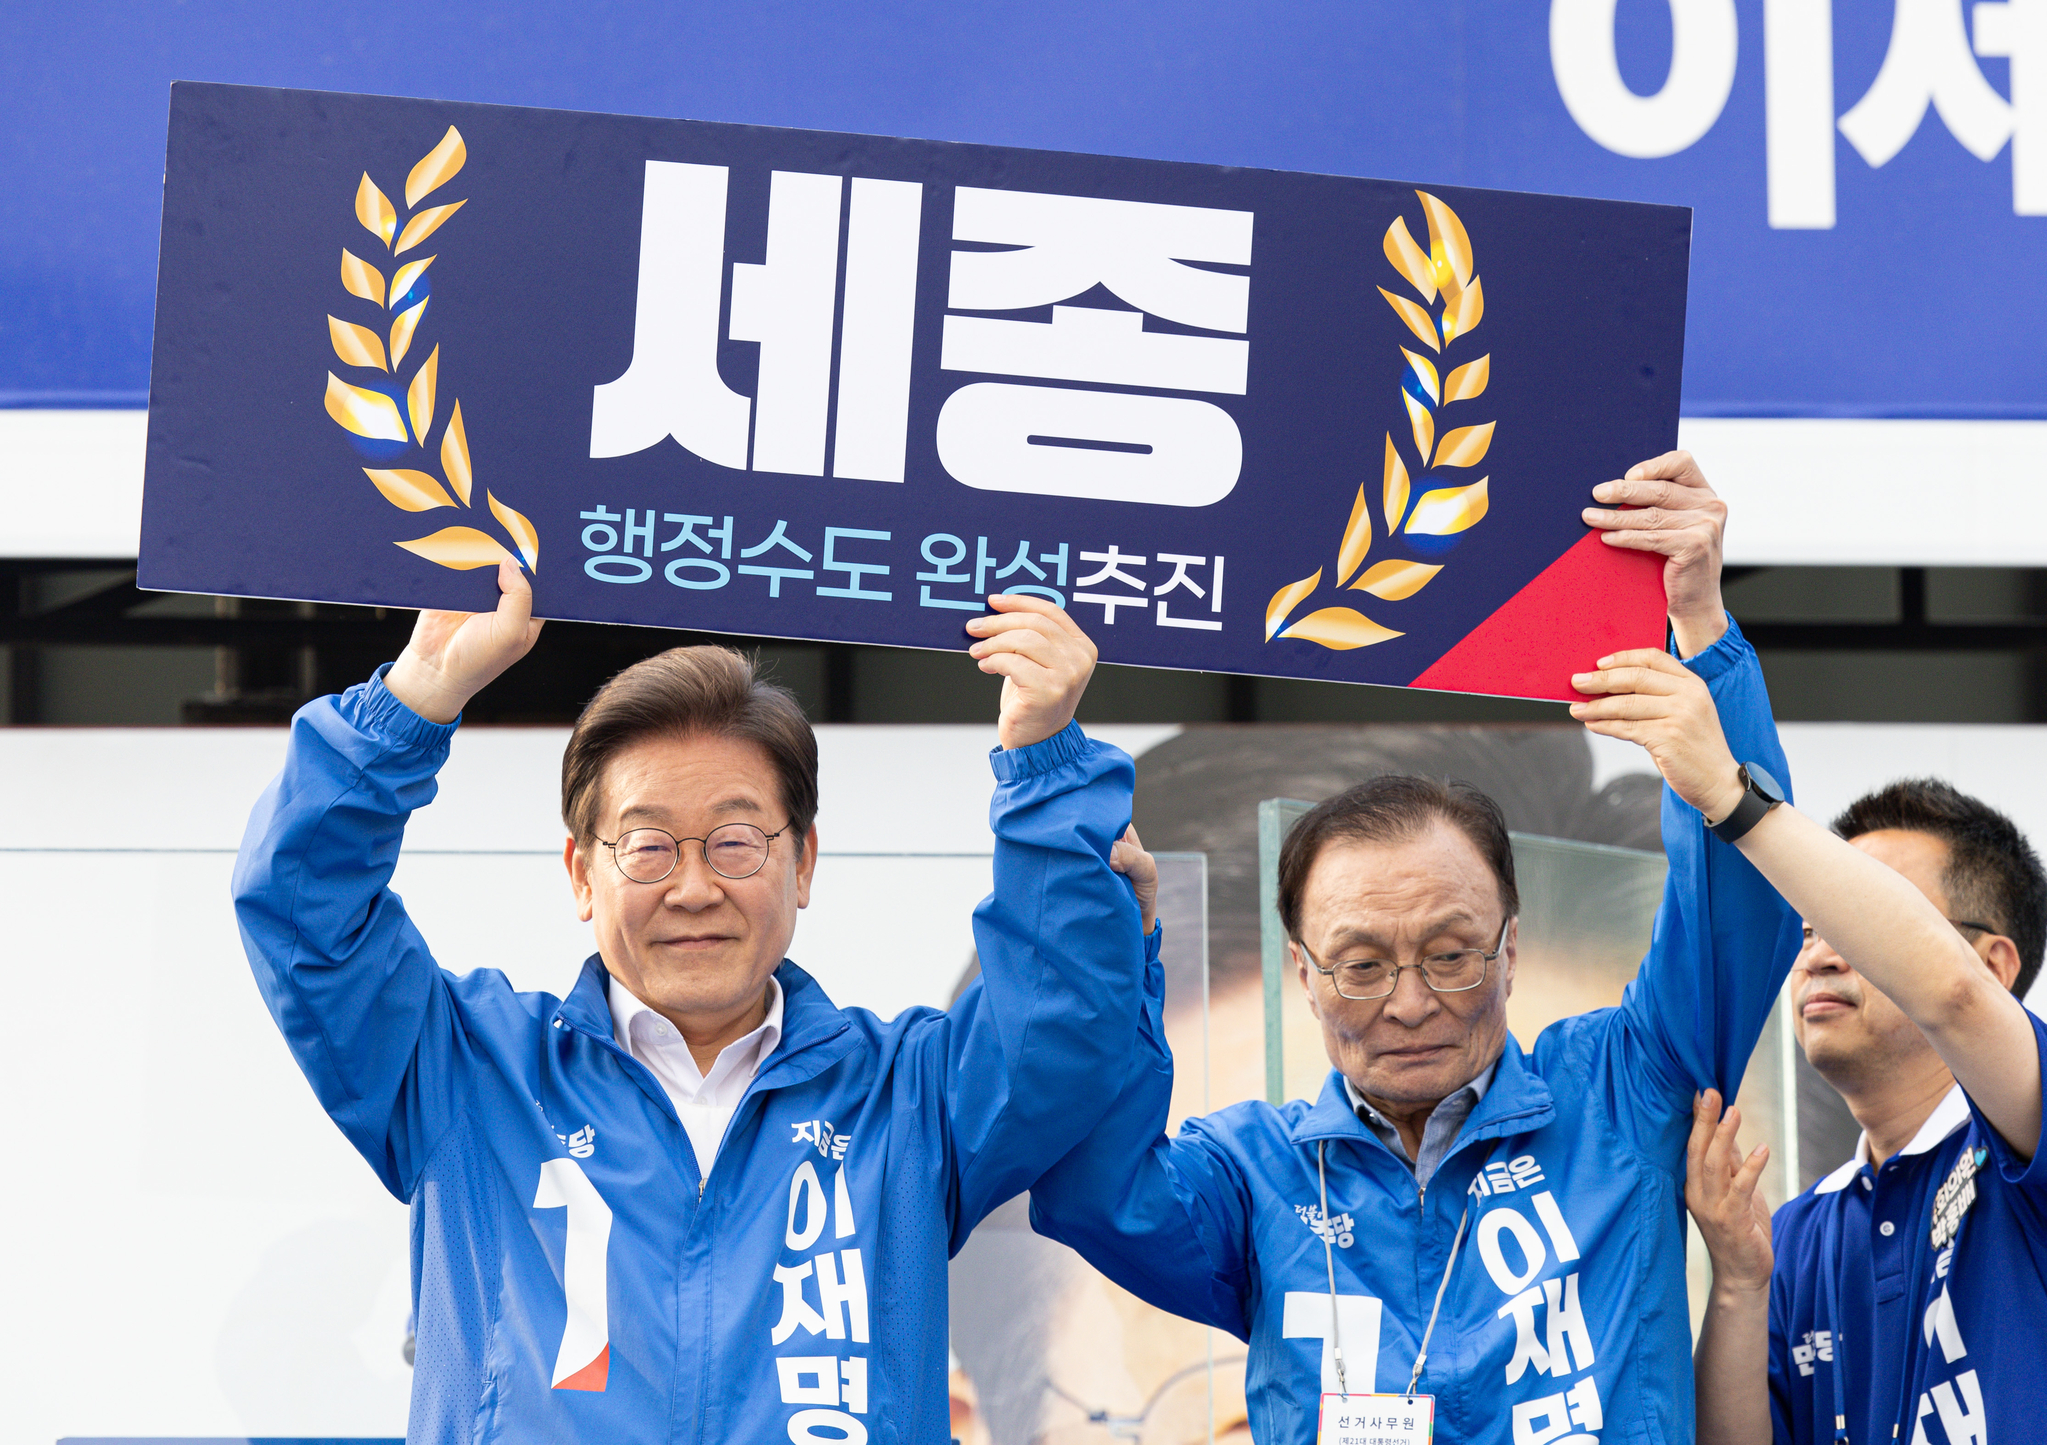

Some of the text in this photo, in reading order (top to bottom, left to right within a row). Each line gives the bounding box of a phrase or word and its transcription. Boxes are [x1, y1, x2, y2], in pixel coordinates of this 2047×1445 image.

[590, 159, 1254, 508] 세종
[579, 505, 893, 602] 행정수도
[791, 1120, 852, 1160] 지금은
[1467, 1155, 1545, 1208] 지금은
[1932, 1146, 1977, 1225] 회의원
[1300, 1213, 1355, 1249] 주당
[533, 1157, 613, 1392] 1
[771, 1160, 870, 1445] 이재명
[1477, 1190, 1604, 1445] 이재명
[1338, 1415, 1414, 1430] 선거사무원
[1338, 1436, 1368, 1445] (제21대
